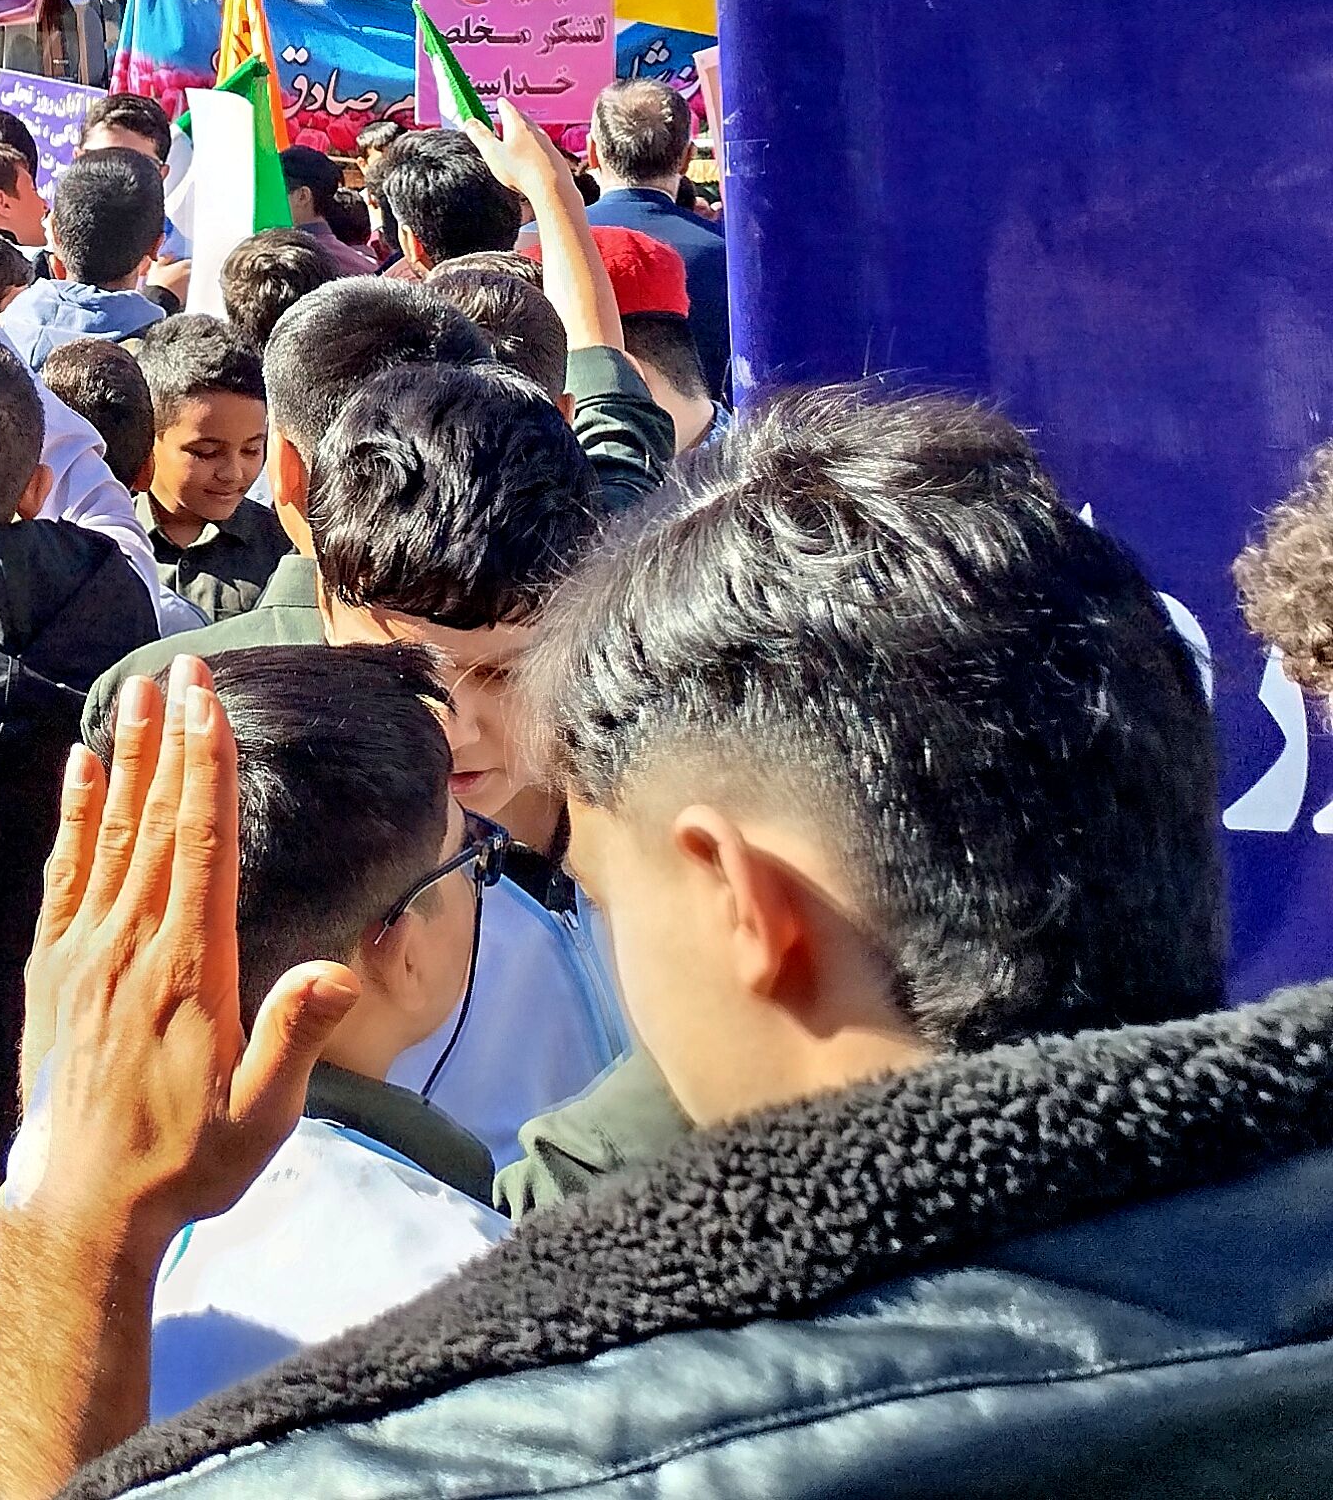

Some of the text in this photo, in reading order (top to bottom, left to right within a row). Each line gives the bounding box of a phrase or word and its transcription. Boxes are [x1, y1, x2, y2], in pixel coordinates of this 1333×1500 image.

[536, 14, 608, 56] لشکر
[282, 45, 380, 121] صادق
[466, 65, 577, 96] خداس
